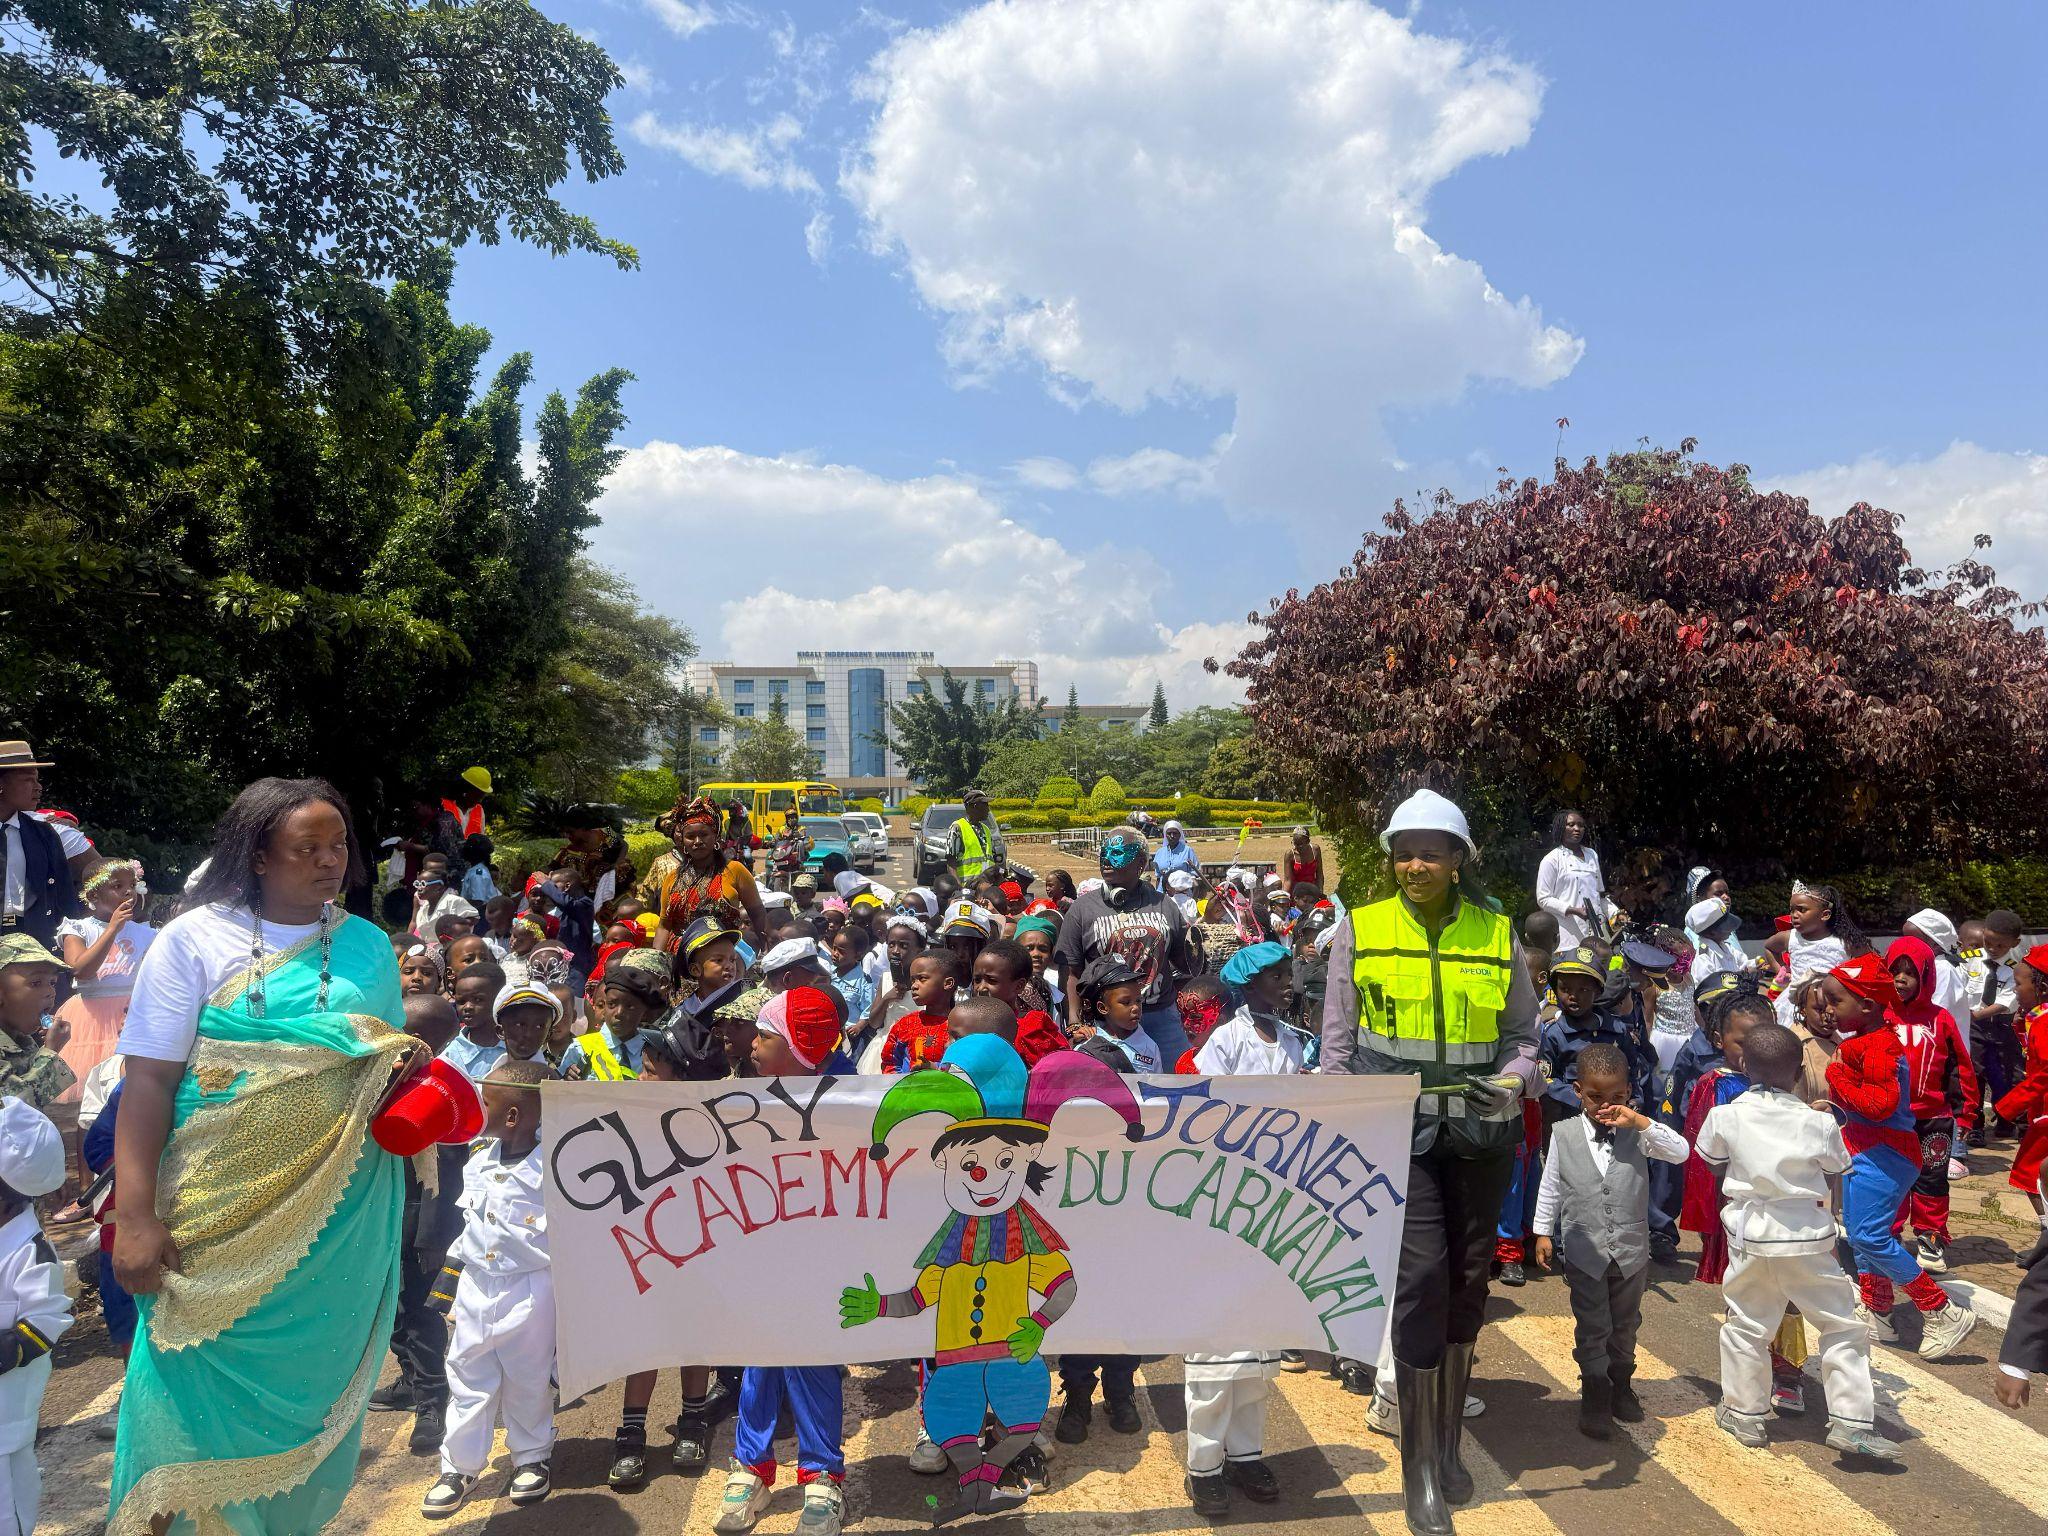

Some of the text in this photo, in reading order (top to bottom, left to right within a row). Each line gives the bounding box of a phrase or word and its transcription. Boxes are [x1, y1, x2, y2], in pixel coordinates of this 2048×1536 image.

[1123, 927, 1149, 940] AND
[551, 1076, 838, 1214] GLORY
[611, 1147, 918, 1295] ACADEMY
[1059, 1146, 1386, 1352] DU CARNAVAL
